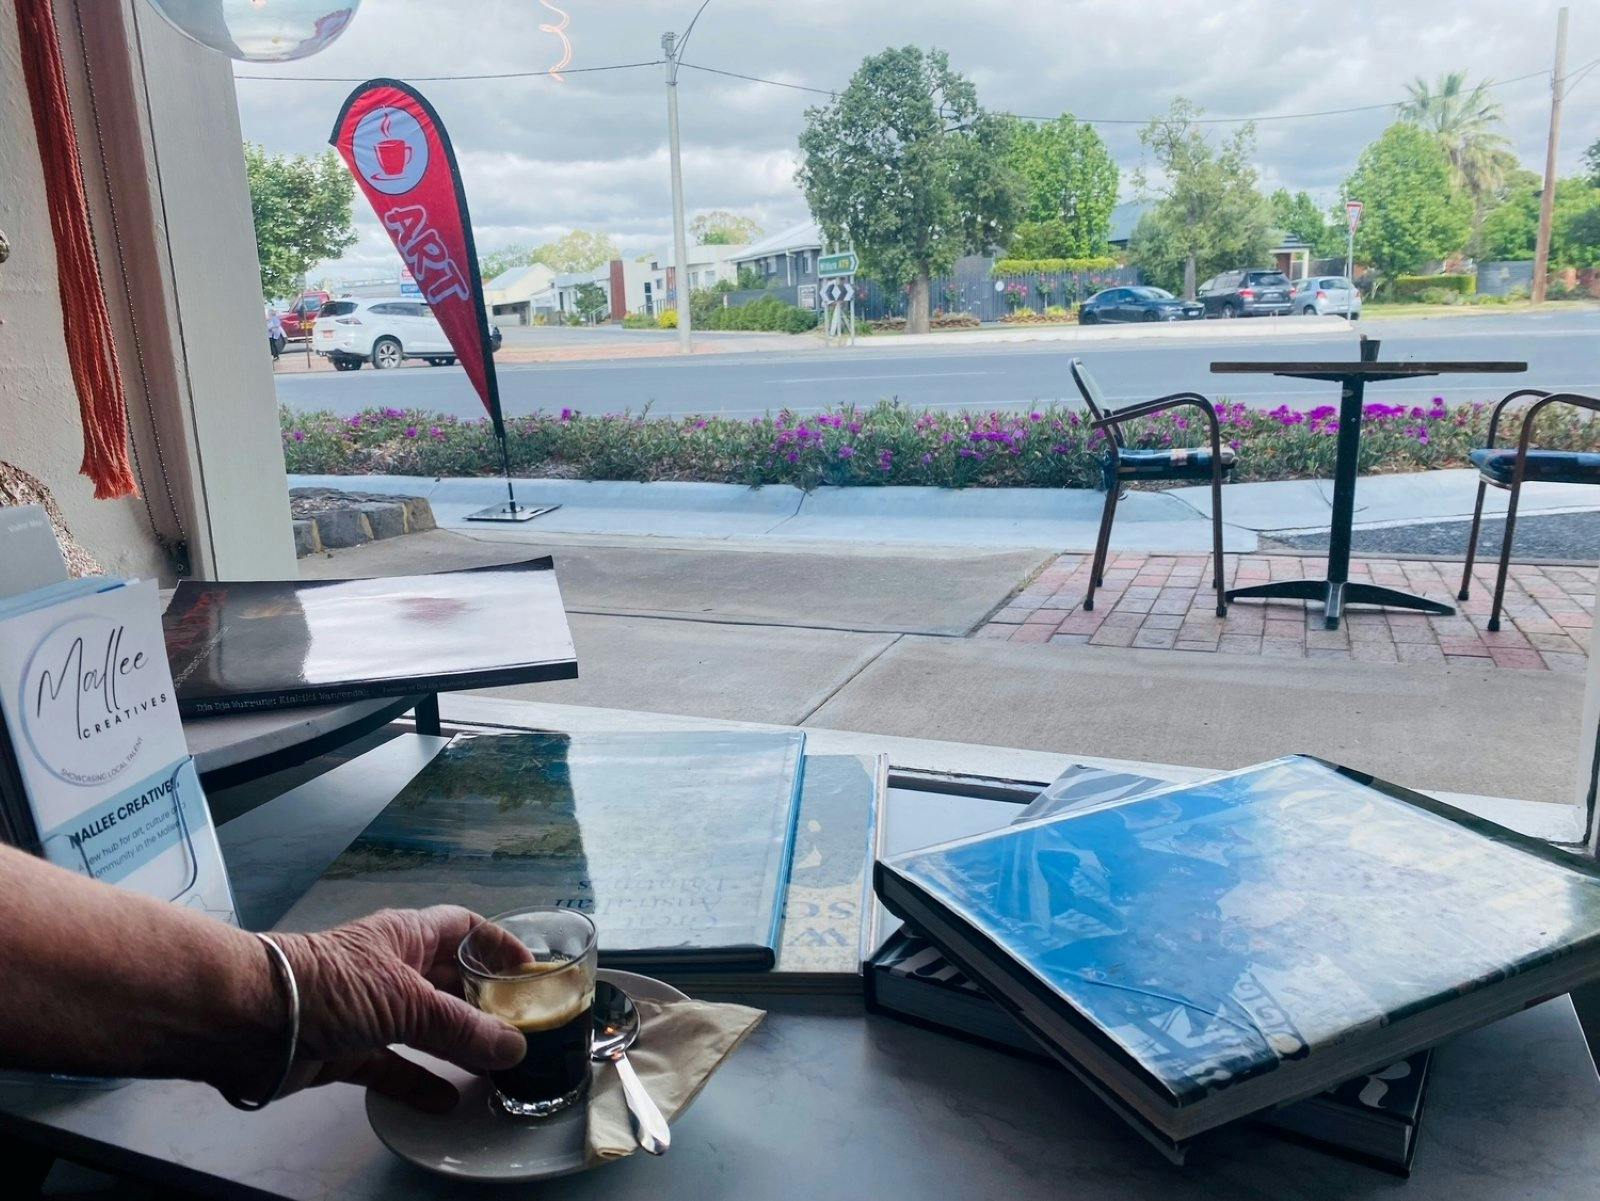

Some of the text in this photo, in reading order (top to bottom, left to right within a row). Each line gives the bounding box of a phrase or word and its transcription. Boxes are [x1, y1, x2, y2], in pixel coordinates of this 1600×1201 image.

[384, 204, 470, 305] ART
[37, 626, 148, 740] Mallee
[83, 694, 167, 739] CREATIVES
[126, 737, 144, 761] TALENT
[93, 850, 136, 878] ommunity
[144, 833, 157, 847] the
[102, 841, 119, 856] hub
[119, 834, 131, 847] for
[145, 810, 170, 831] culture
